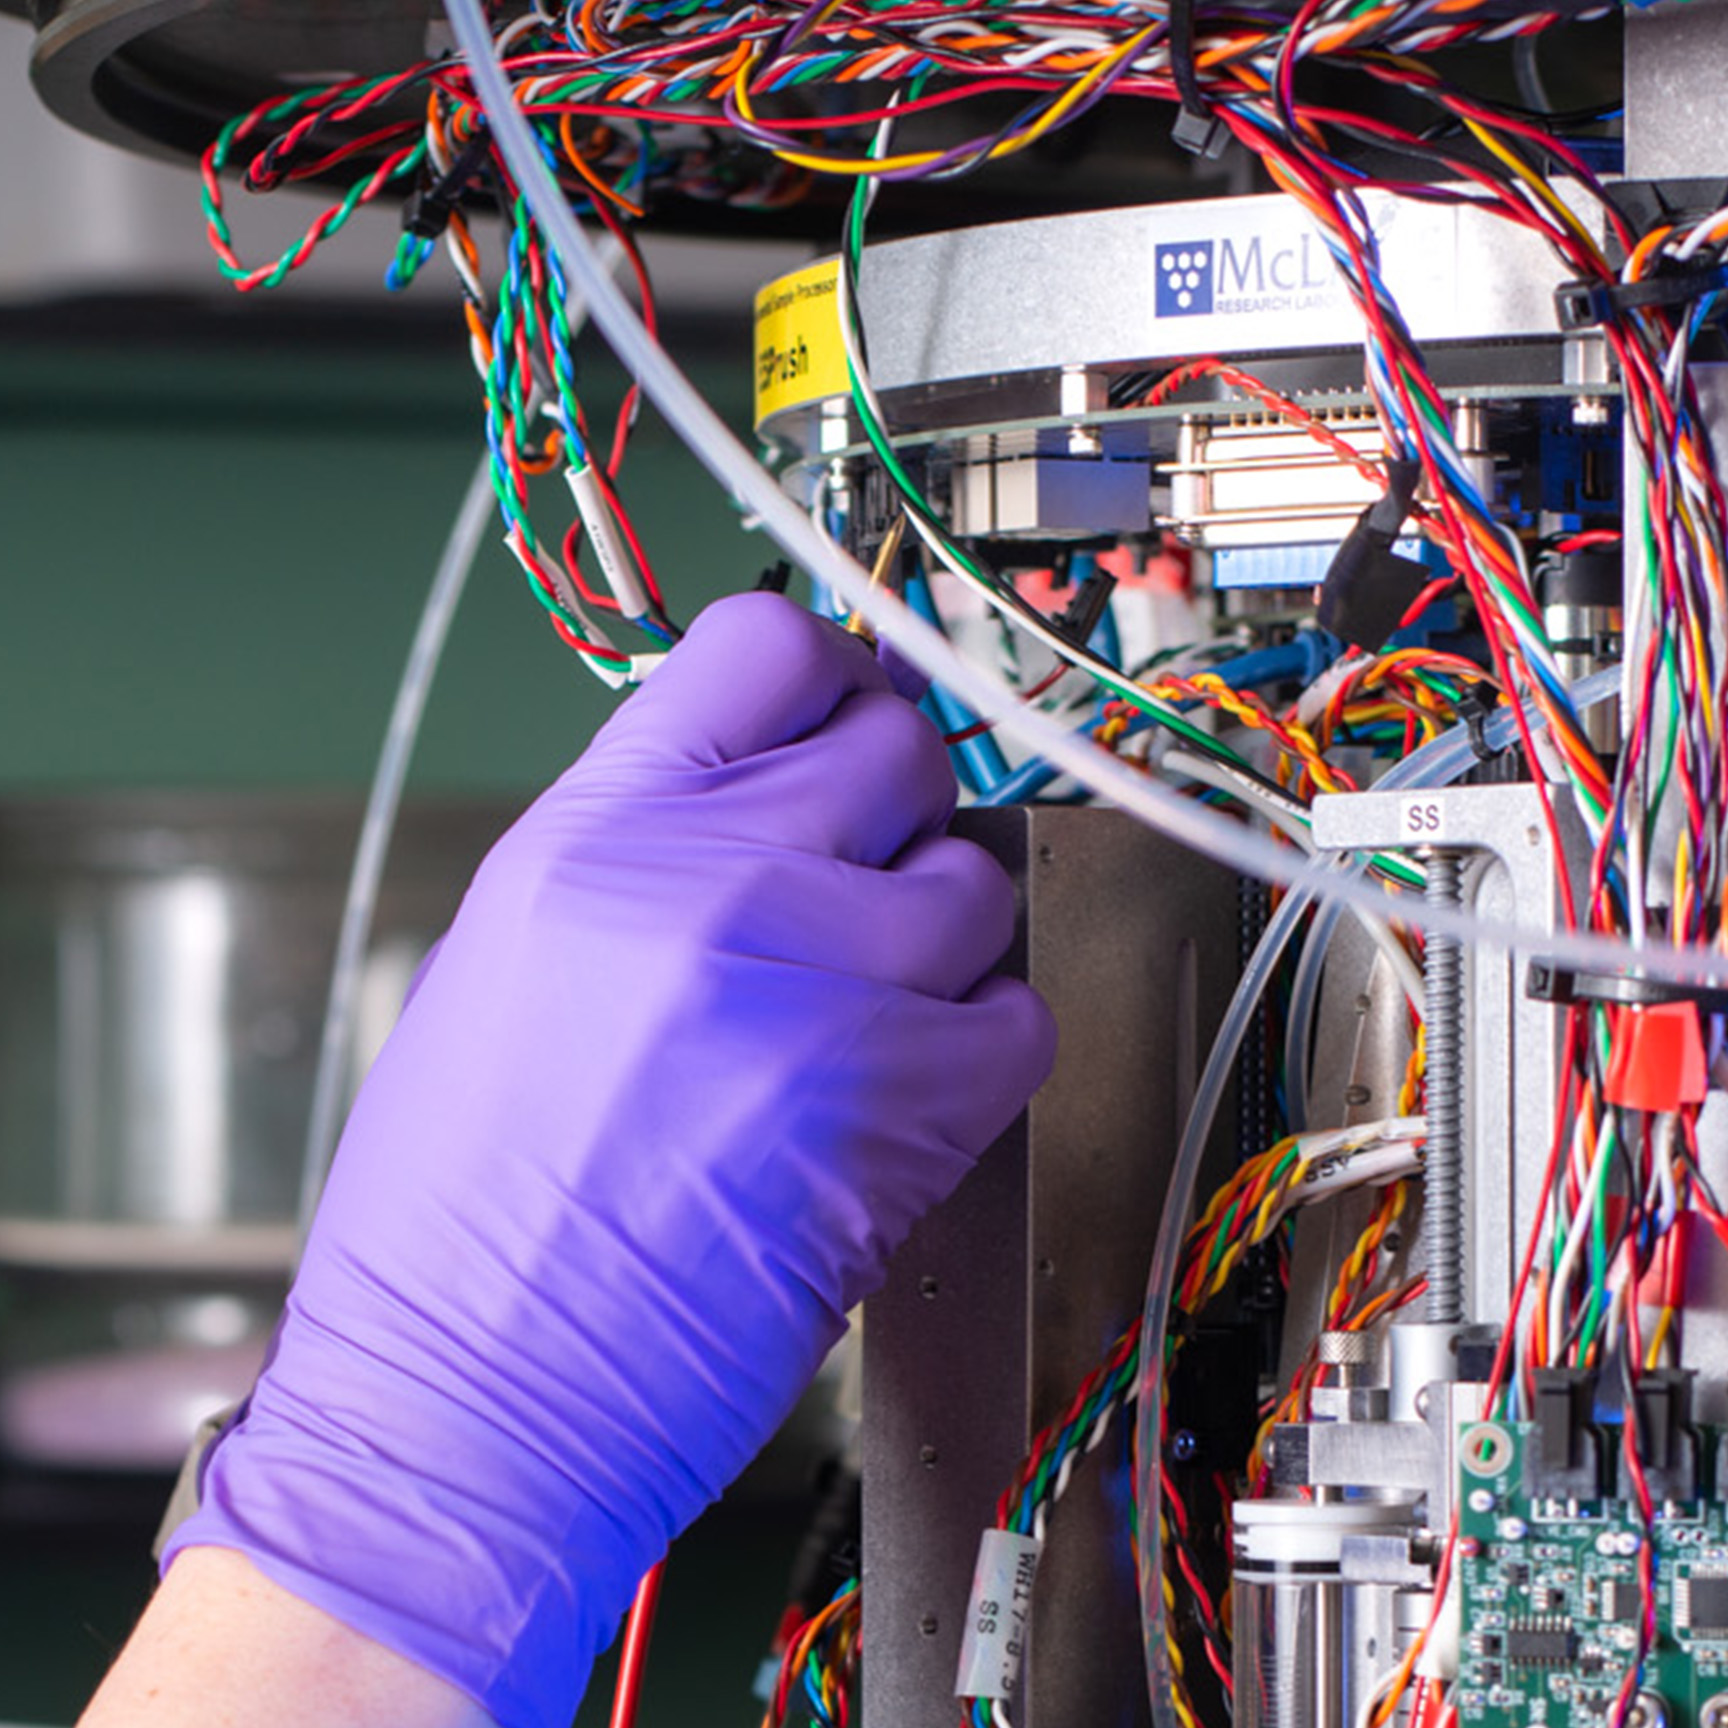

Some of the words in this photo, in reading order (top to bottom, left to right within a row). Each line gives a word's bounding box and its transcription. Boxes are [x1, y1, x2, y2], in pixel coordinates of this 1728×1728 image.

[1216, 233, 1334, 294] McL
[1216, 296, 1292, 314] RESEARCH
[1408, 804, 1440, 832] SS
[977, 1601, 999, 1634] SS
